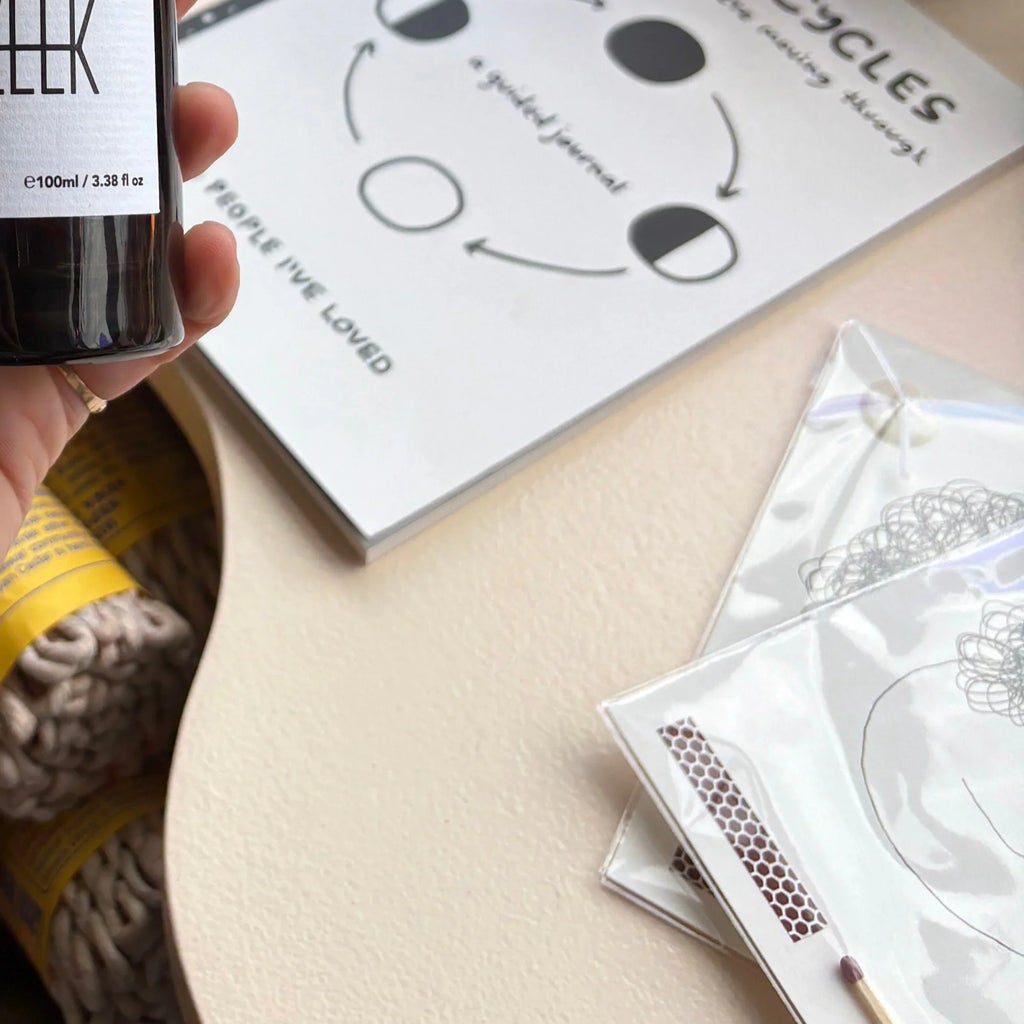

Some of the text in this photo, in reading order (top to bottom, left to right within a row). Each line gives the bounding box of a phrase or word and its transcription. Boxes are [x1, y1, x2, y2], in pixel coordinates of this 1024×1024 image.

[477, 70, 558, 129] guided
[537, 124, 629, 195] journal
[757, 25, 832, 89] moving
[840, 90, 928, 166] through
[82, 174, 89, 189] /
[91, 174, 119, 188] 3.38
[121, 173, 129, 187] fl
[131, 176, 144, 187] oz
[204, 178, 394, 376] PEOPLE I'VE LOVED
